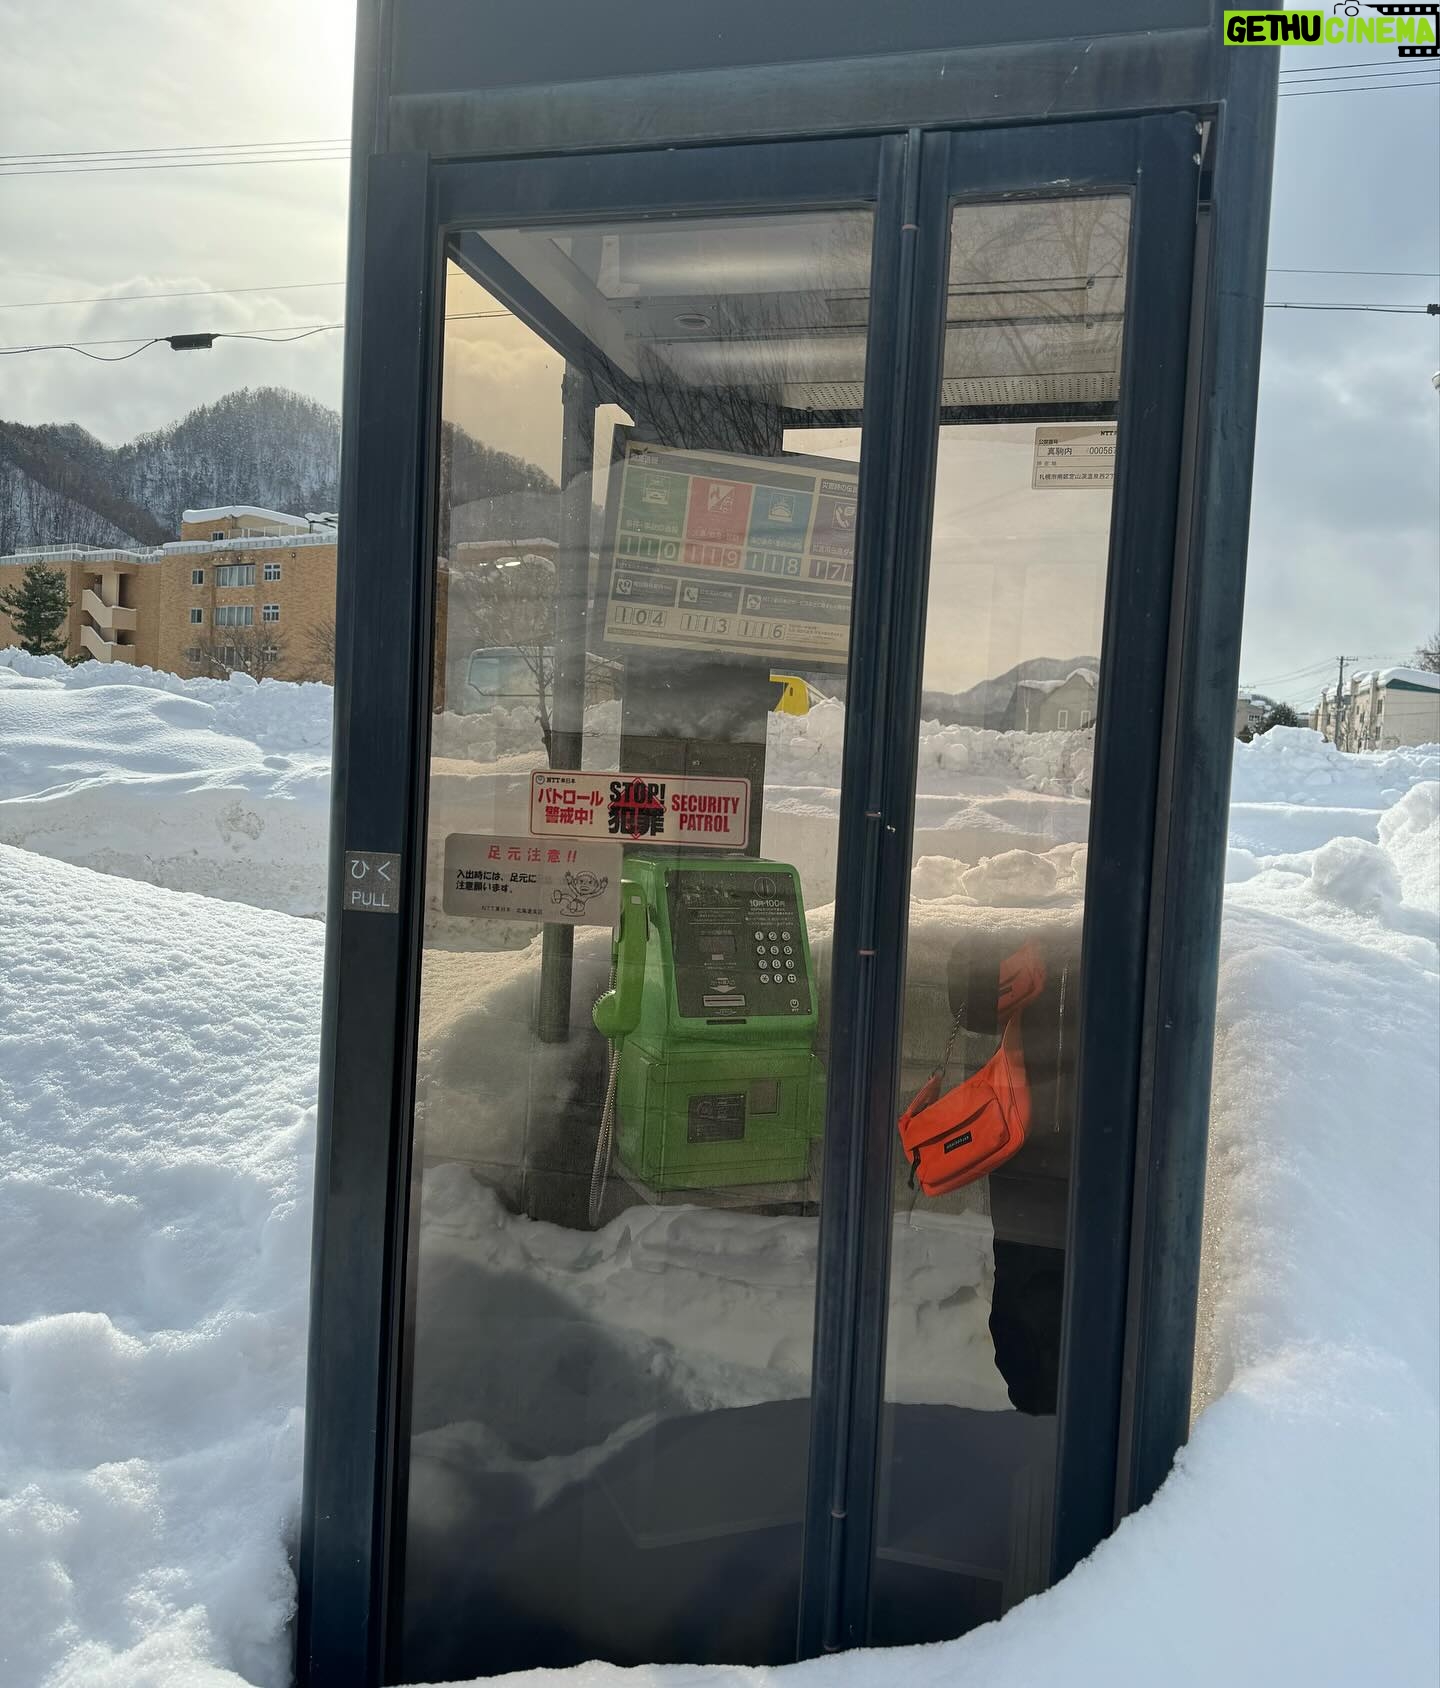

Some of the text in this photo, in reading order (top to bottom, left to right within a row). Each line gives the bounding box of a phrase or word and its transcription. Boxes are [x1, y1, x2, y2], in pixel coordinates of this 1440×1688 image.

[1048, 447, 1072, 455] 真駒内
[626, 537, 844, 579] 110 119 118 17
[621, 607, 664, 626] 104
[687, 615, 728, 633] 113
[743, 622, 783, 638] 116
[538, 788, 603, 806] パトロール
[609, 781, 666, 804] STOP!
[671, 794, 740, 814] SECURITY
[545, 806, 594, 825] 警戒中!
[608, 805, 665, 836] 犯罪
[679, 813, 730, 833] PATROL
[487, 845, 577, 863] 足元注意!!
[351, 860, 391, 881] ひく
[351, 890, 390, 907] PULL
